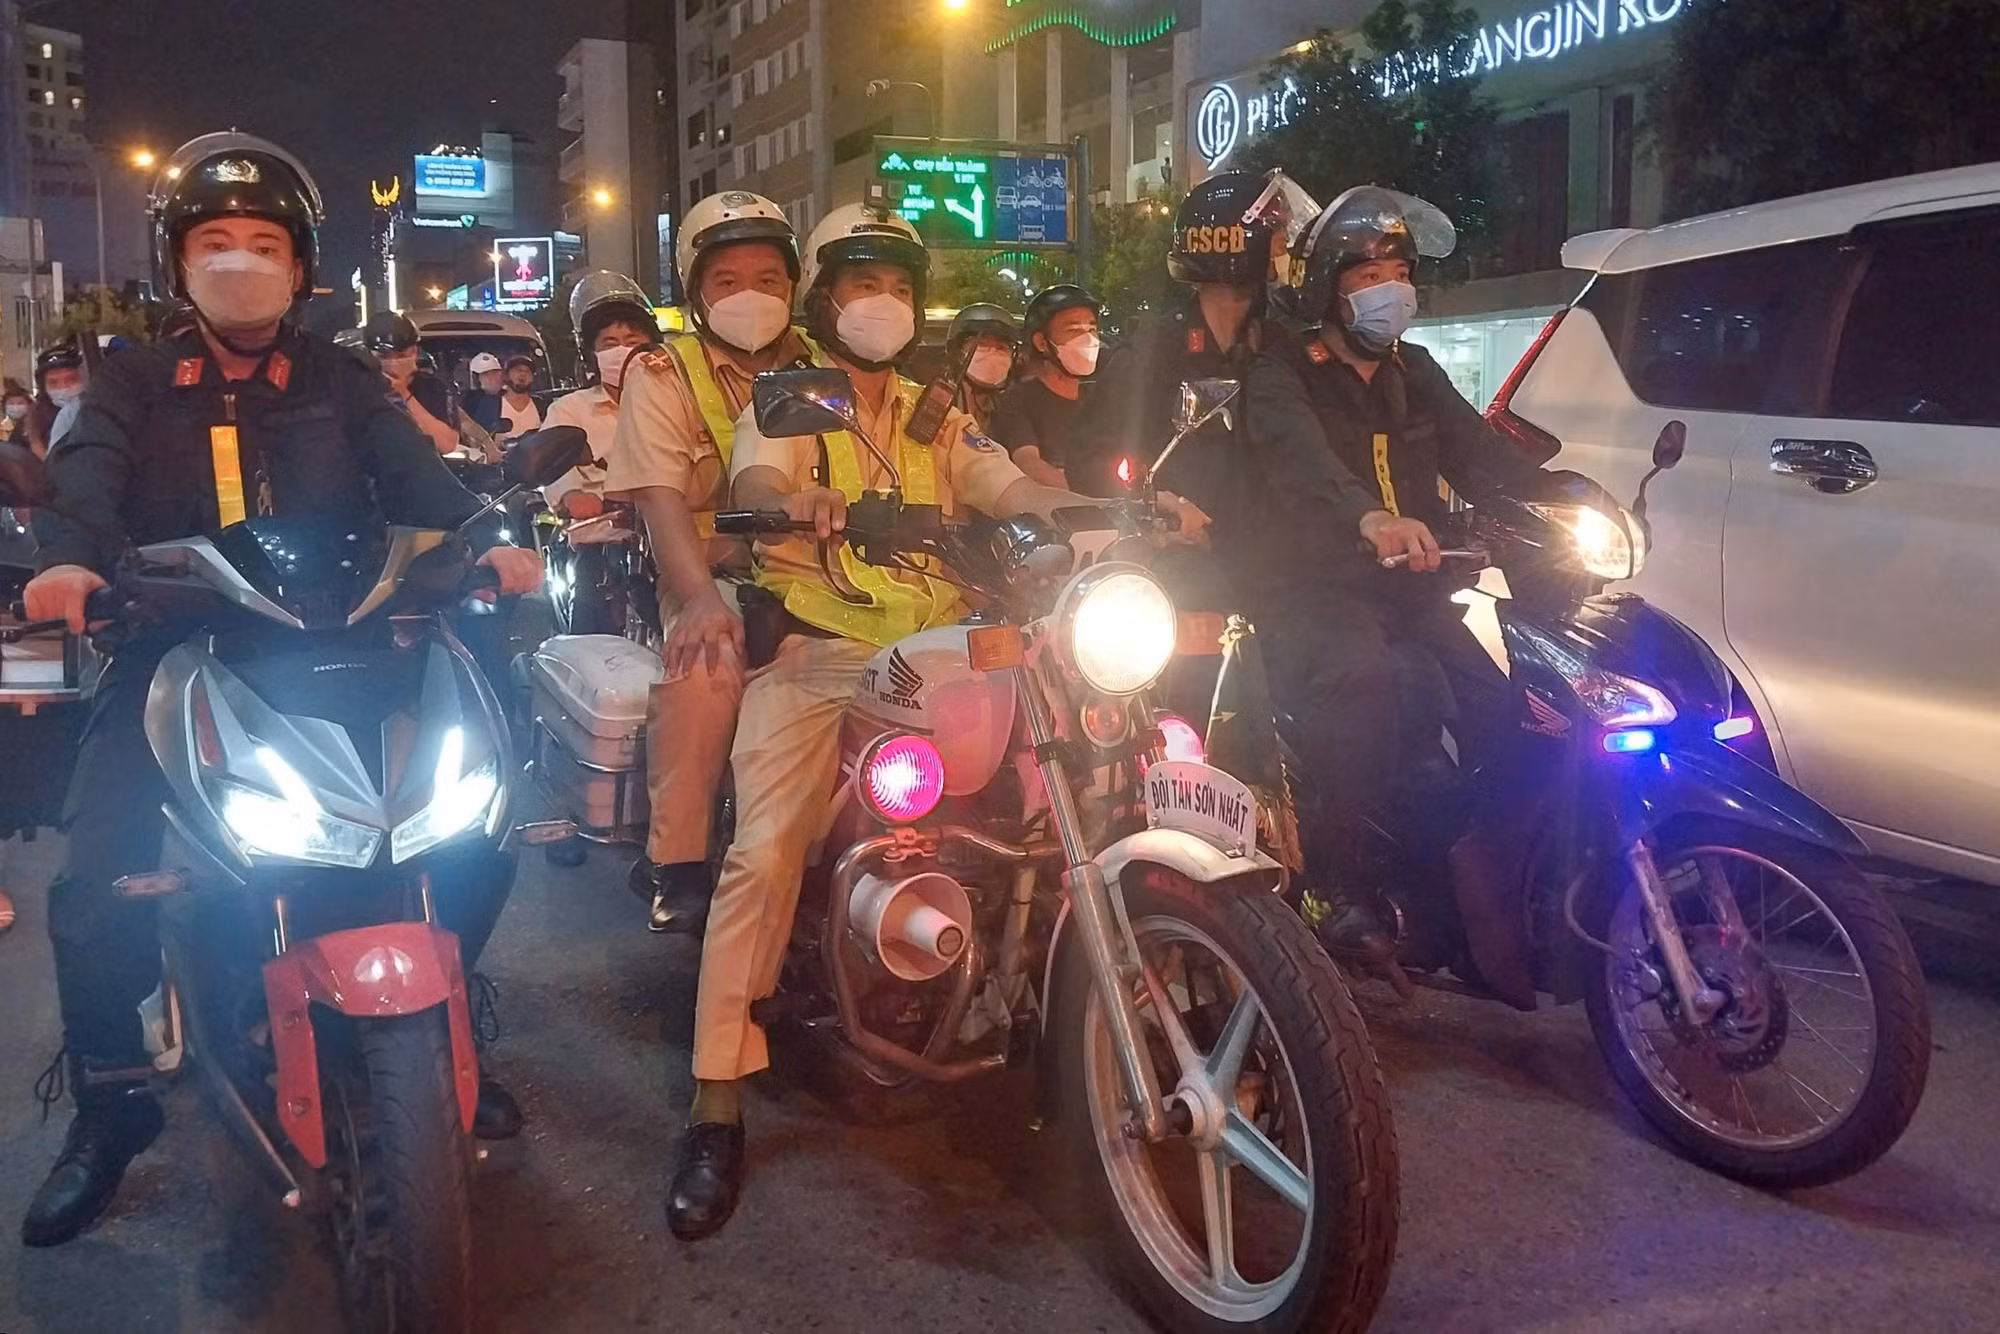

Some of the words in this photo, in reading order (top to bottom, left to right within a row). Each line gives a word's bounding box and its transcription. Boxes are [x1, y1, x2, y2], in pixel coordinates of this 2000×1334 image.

[313, 662, 368, 673] HONDA
[879, 690, 923, 711] HONDA
[1520, 720, 1570, 739] HONDA
[1151, 771, 1170, 816] ĐỘI
[1171, 770, 1192, 811] TÂN
[1194, 781, 1217, 818] SƠN
[1218, 791, 1249, 835] NHẤT
